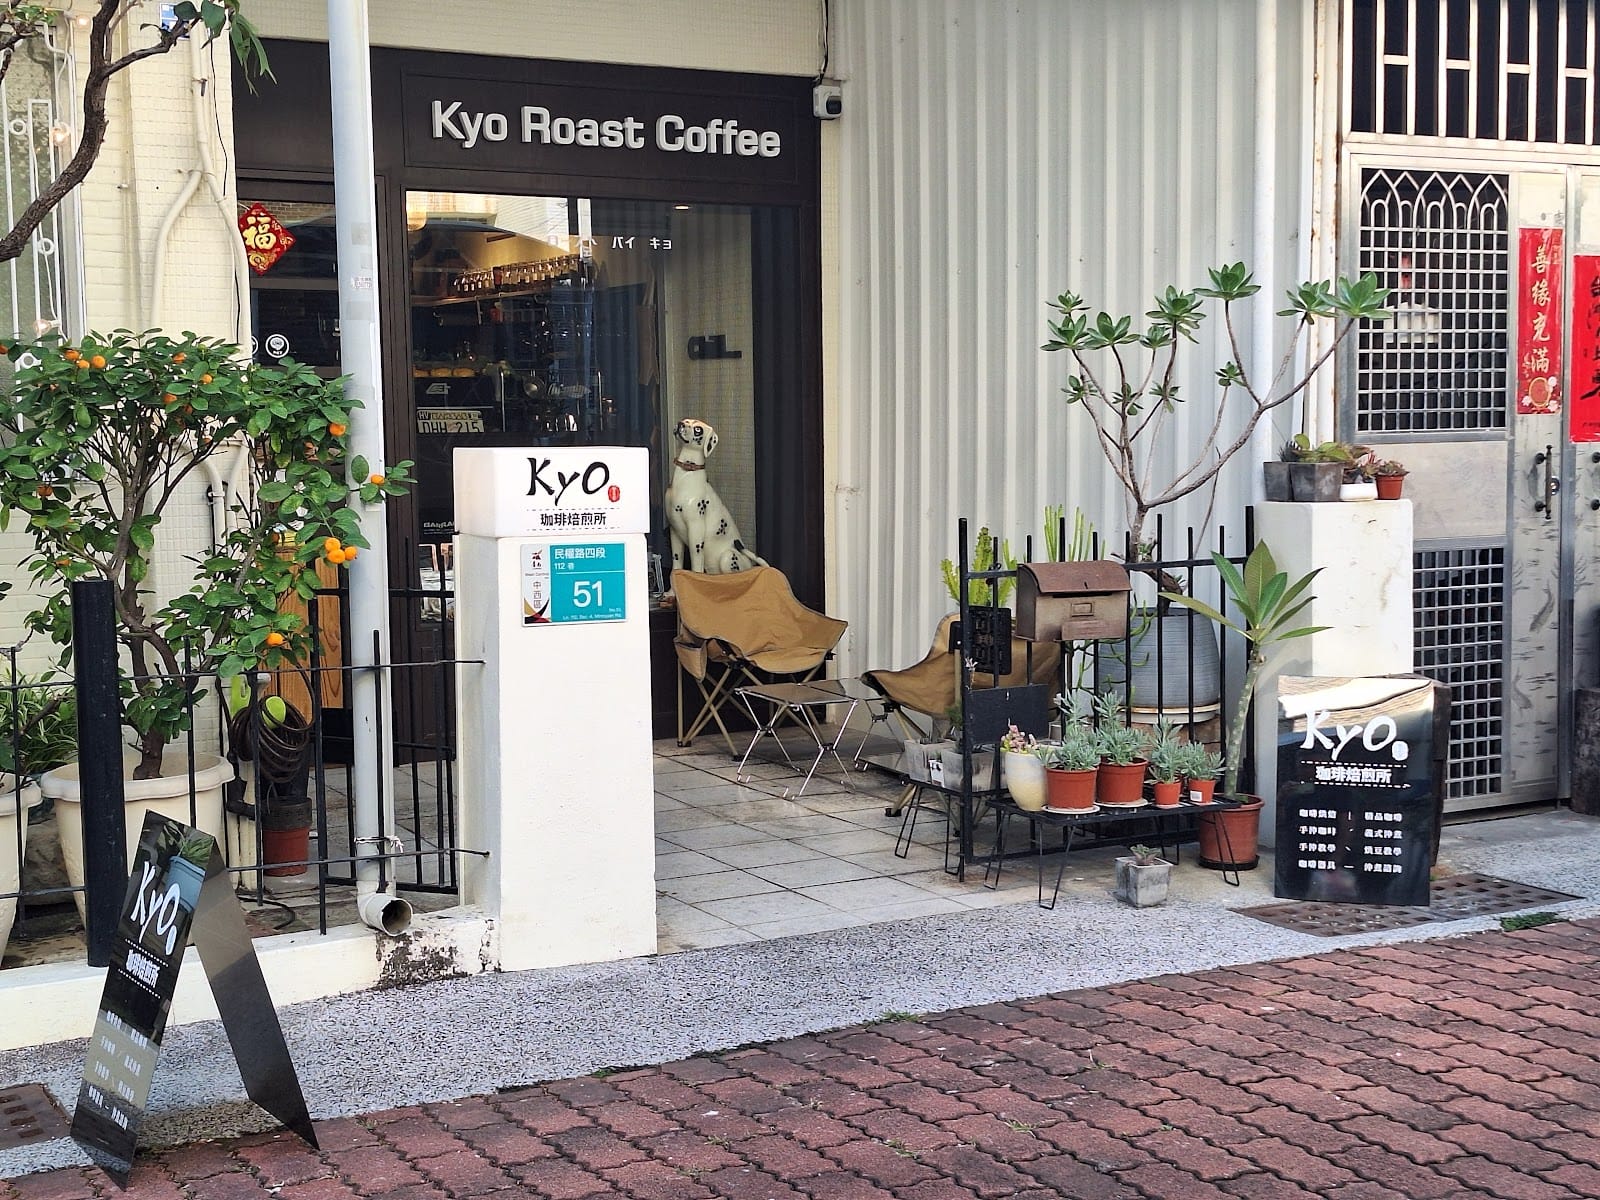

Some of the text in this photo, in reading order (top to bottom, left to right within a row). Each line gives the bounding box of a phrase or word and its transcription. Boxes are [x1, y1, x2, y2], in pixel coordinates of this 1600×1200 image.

[432, 100, 781, 157] Kyo Roast Coffee
[242, 212, 277, 250] 福
[540, 512, 607, 526] 珈琲焙煎所
[554, 547, 606, 560] 民權路四段
[573, 580, 603, 608] 51
